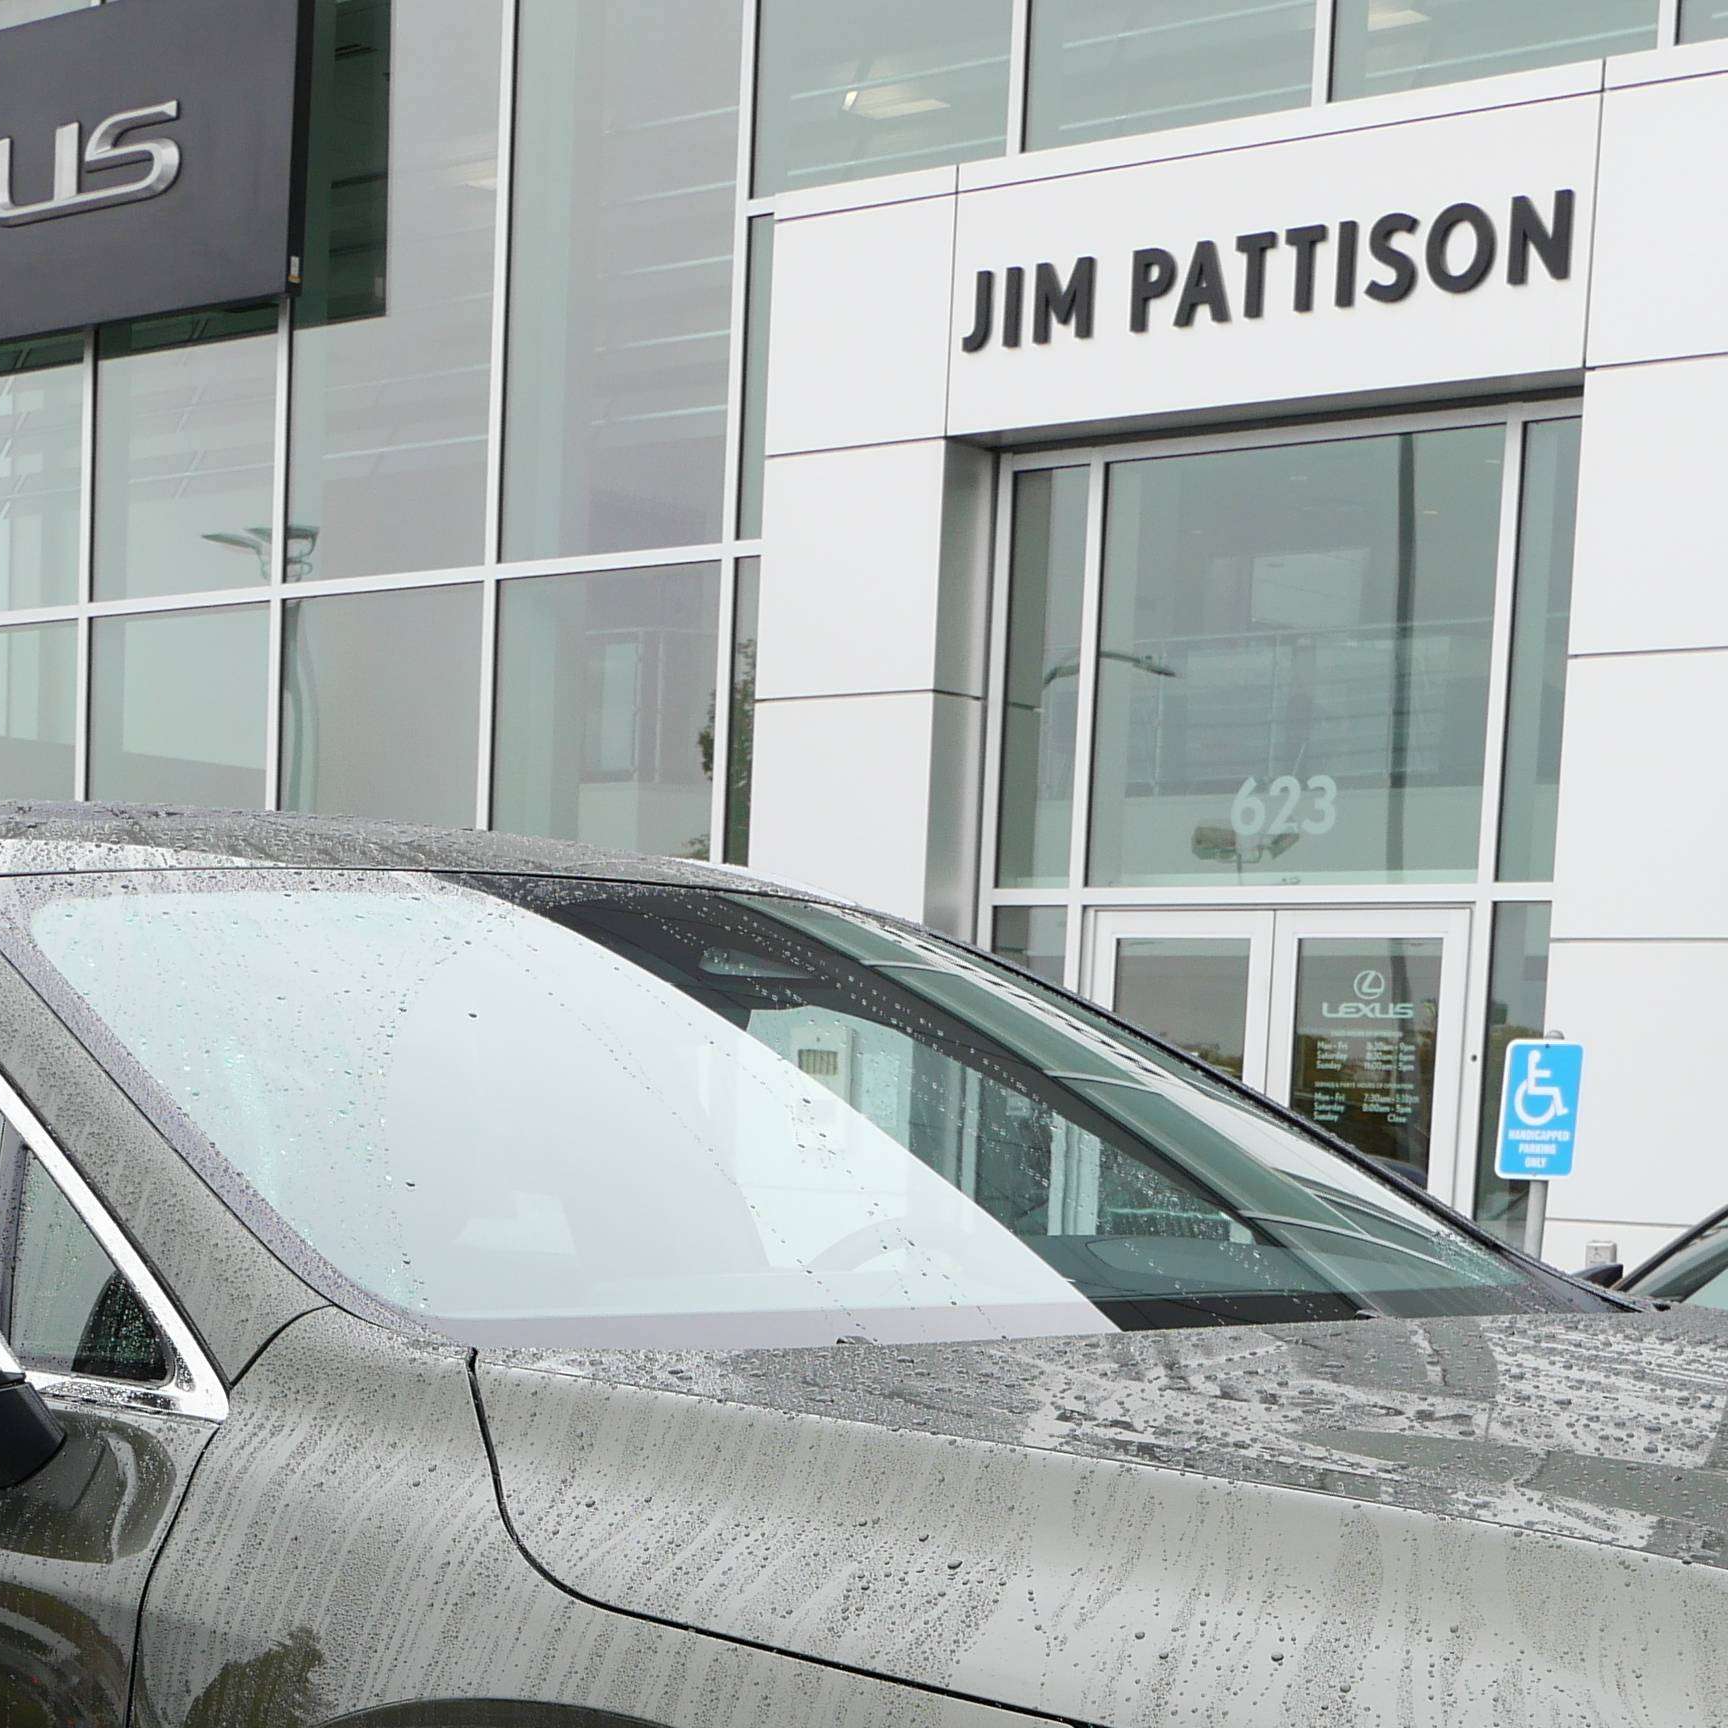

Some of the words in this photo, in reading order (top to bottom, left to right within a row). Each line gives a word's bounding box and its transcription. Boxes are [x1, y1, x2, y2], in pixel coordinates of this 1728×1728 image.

[962, 256, 1097, 353] JIM
[1129, 188, 1575, 334] PATTISON
[1230, 774, 1338, 836] 623
[1322, 1001, 1414, 1019] LEXUS
[1316, 1051, 1349, 1063] Saturday
[1316, 1060, 1343, 1072] Sunday
[1313, 1102, 1345, 1114] Saturday
[1313, 1111, 1339, 1122] Sunday
[1507, 1128, 1570, 1141] HANDICAPPED
[1518, 1143, 1557, 1155] PARKING
[1524, 1157, 1548, 1169] ONLY
